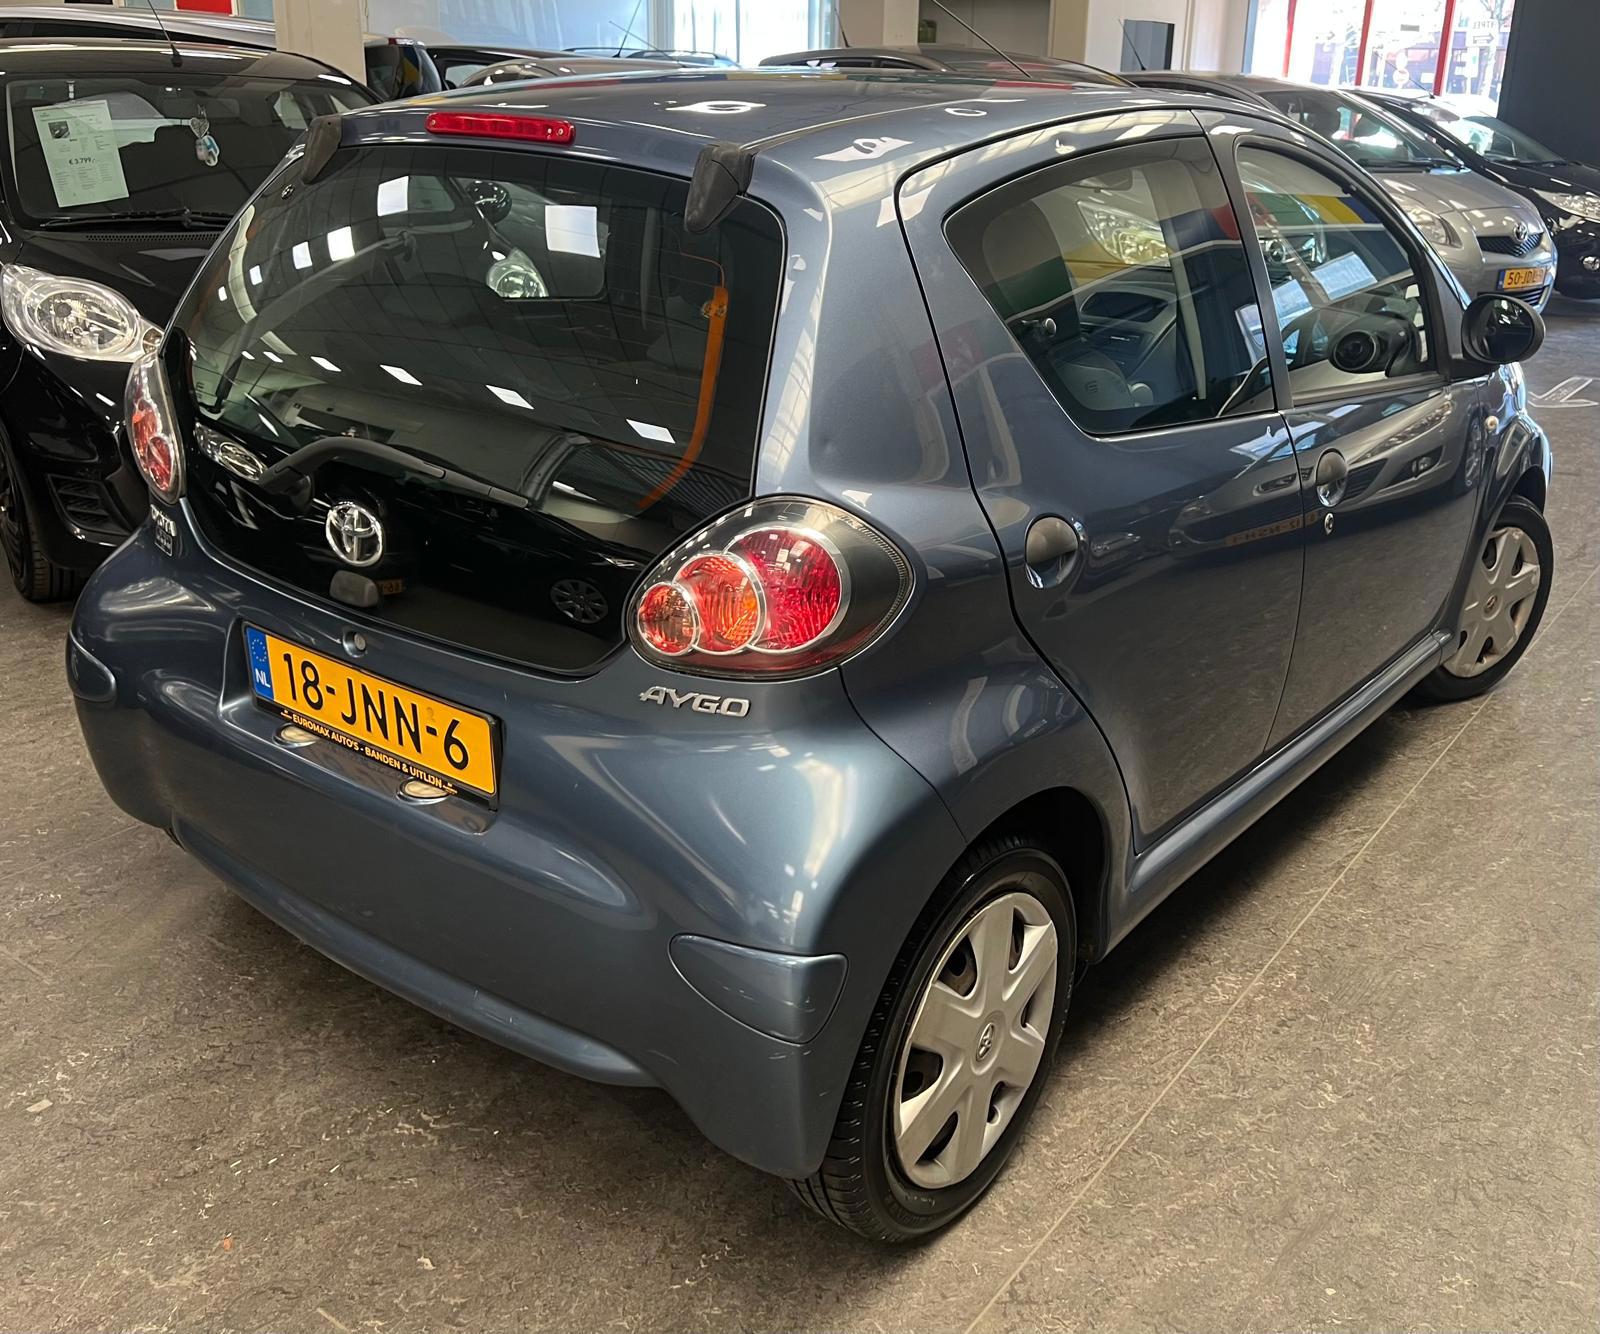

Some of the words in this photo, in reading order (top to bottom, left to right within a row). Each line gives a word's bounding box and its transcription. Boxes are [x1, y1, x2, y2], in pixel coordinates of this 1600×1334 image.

[255, 668, 271, 689] NL
[638, 685, 750, 718] AYGO
[283, 652, 469, 771] 18-JNN-6
[292, 713, 330, 738] EUROMAX
[331, 731, 359, 751] AUTO'S
[364, 746, 401, 770] BANDEN
[401, 763, 409, 773] &
